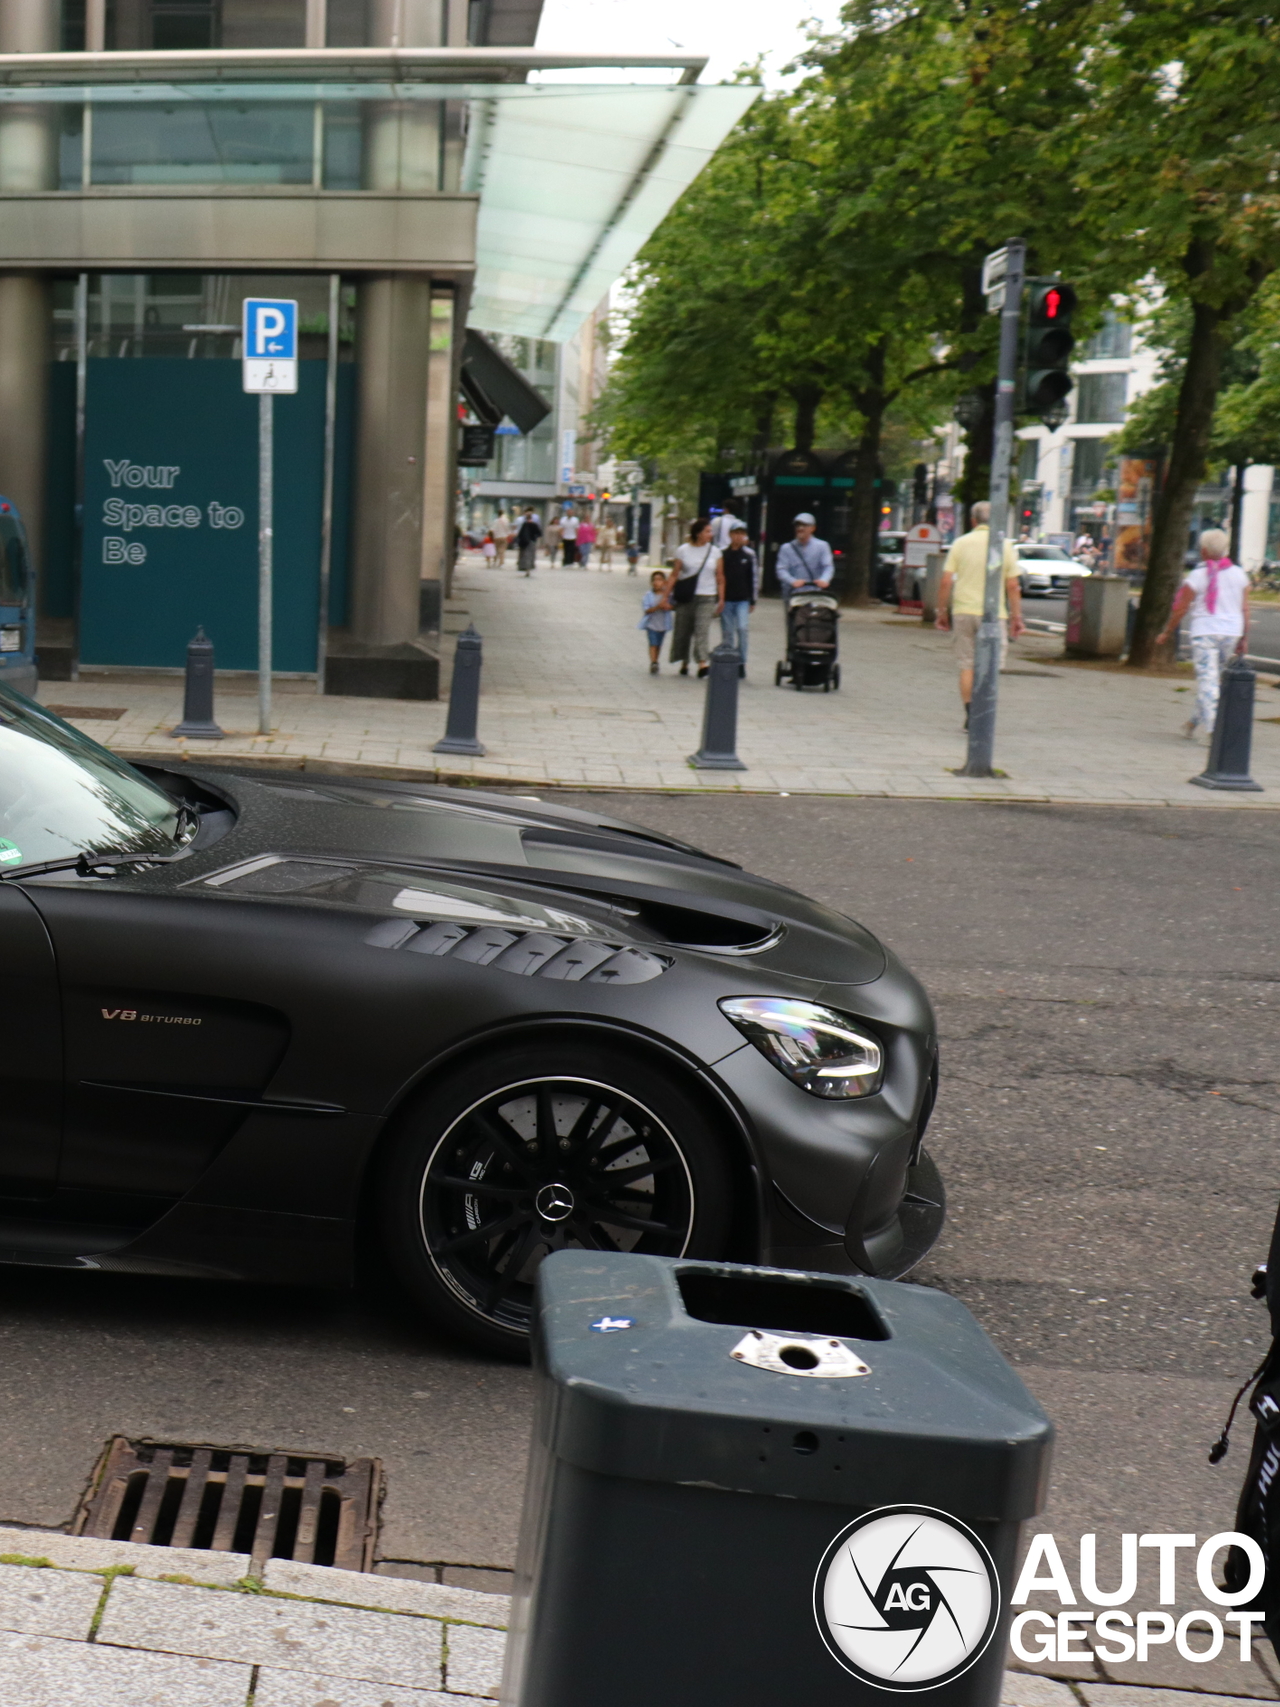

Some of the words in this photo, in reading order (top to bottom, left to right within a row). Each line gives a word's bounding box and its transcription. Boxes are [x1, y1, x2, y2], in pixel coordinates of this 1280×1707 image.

[256, 307, 285, 355] P
[103, 459, 181, 489] Your
[102, 497, 202, 532] Space
[207, 501, 245, 529] to
[102, 536, 147, 565] Be
[101, 1008, 137, 1021] V8
[140, 1014, 202, 1026] BITURBO
